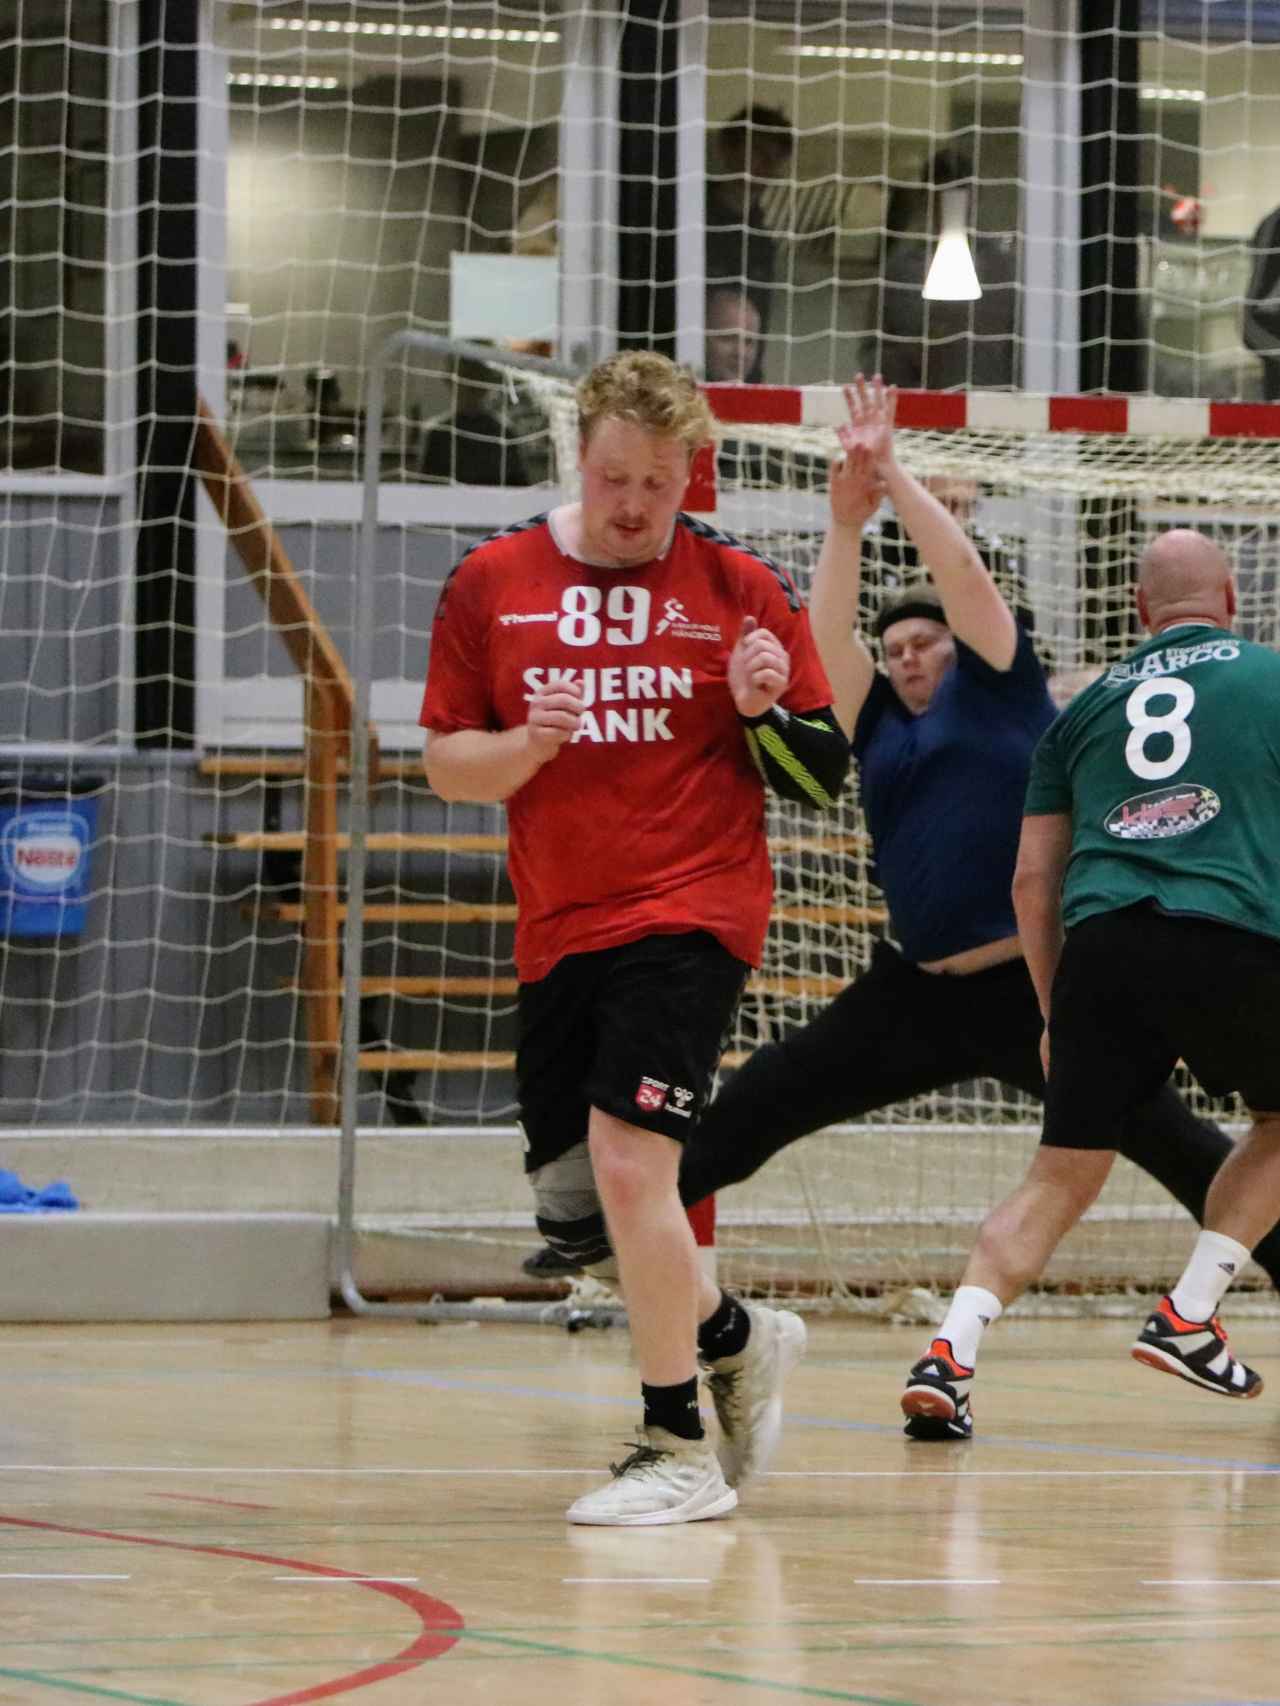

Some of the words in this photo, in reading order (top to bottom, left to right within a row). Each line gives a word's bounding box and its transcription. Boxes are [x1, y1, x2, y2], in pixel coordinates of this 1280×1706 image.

[557, 585, 651, 646] 89
[569, 707, 675, 744] ANK
[1125, 677, 1195, 780] 8
